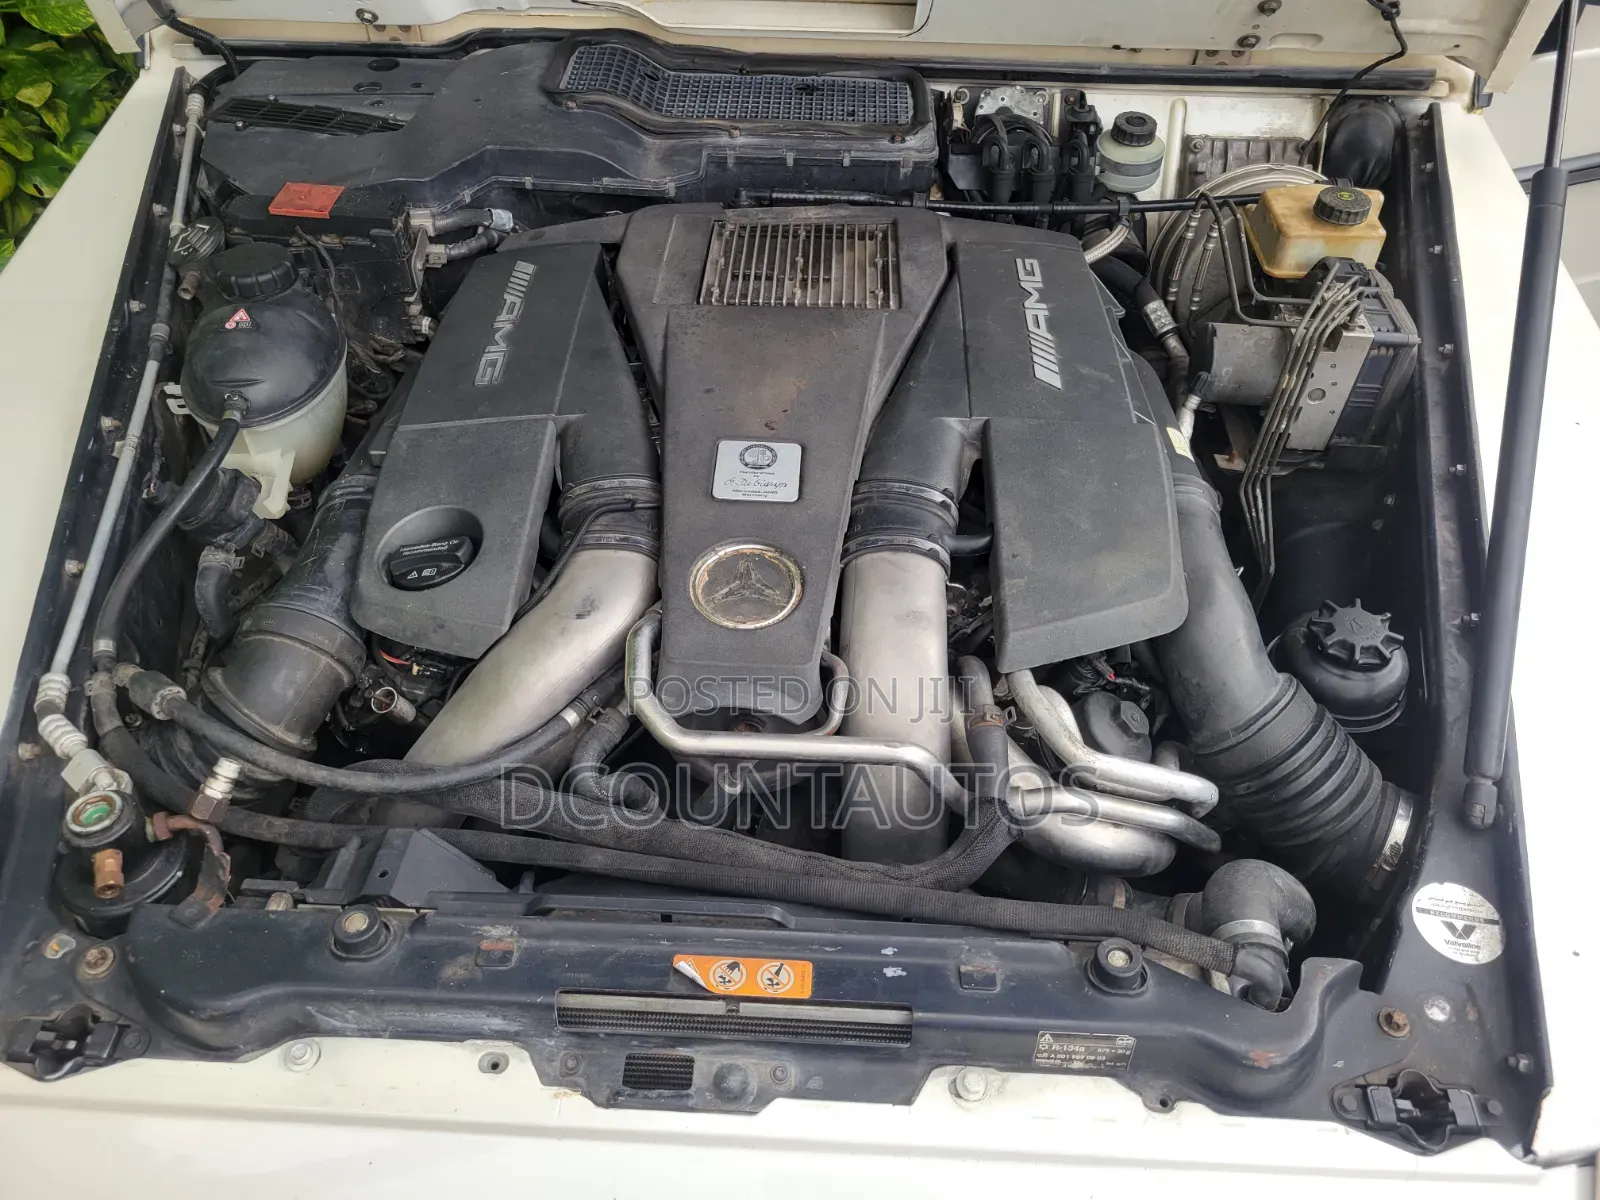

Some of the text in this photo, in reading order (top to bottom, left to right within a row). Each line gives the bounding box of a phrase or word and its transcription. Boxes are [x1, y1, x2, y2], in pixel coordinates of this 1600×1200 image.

[1015, 257, 1056, 343] AMG
[474, 290, 526, 386] AMG
[1429, 909, 1485, 924] RECOMMENDS
[1444, 938, 1482, 951] Valvoline
[1052, 1043, 1085, 1053] R-134a
